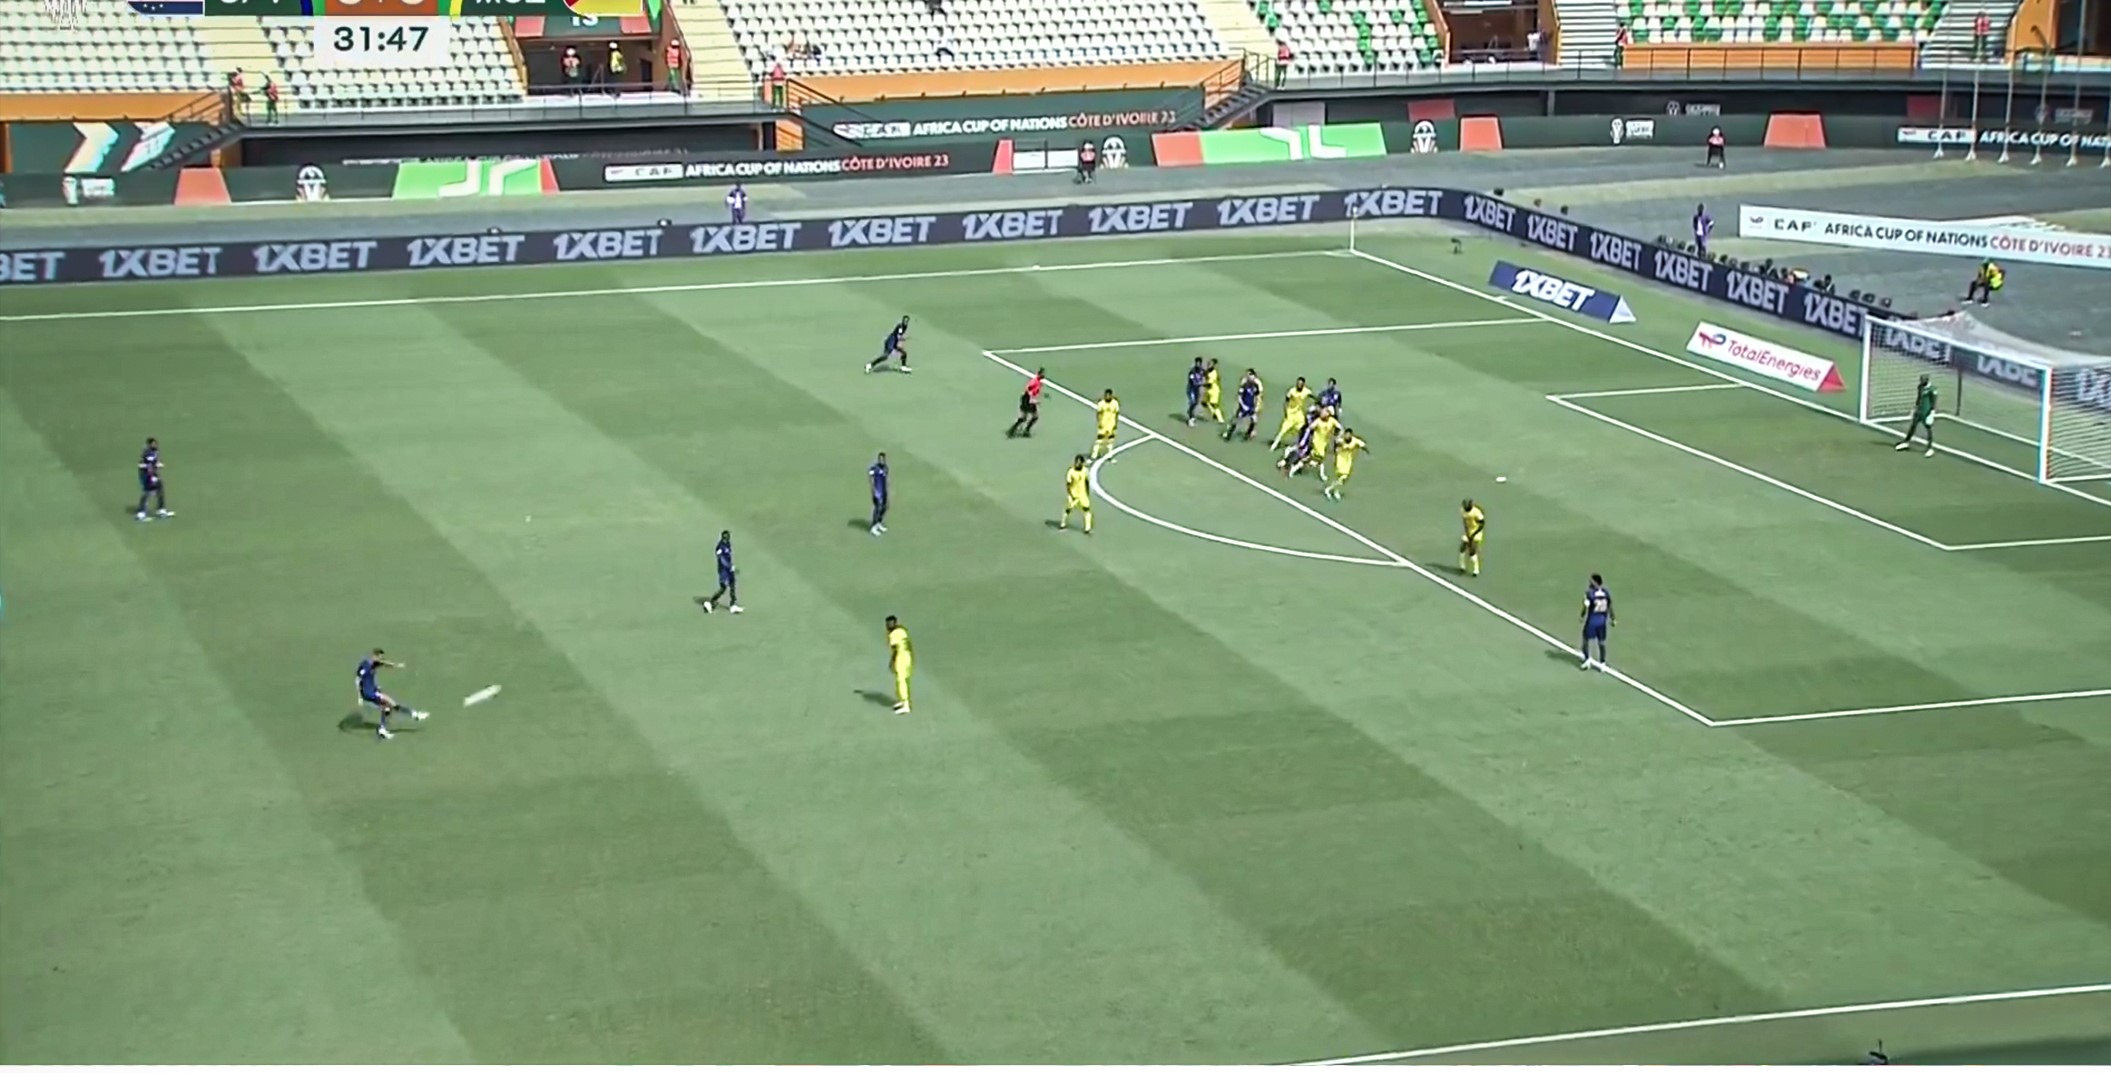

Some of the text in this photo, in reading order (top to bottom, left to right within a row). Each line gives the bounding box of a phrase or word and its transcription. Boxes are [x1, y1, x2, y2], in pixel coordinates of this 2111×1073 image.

[913, 121, 961, 136] AFRICA
[963, 119, 990, 133] CUP
[990, 118, 1009, 131] OF
[1010, 115, 1067, 130] NATIONS
[1068, 112, 1100, 128] CÔTE
[1980, 130, 2028, 144] AFRCA
[685, 163, 735, 178] AFRICA
[736, 162, 764, 177] CUP
[764, 161, 783, 175] OF
[784, 158, 841, 174] NATIONS
[841, 156, 874, 171] CÔTE
[876, 154, 932, 169] D'IVOIRE
[934, 154, 949, 167] 23
[1088, 202, 1194, 232] 1XBET
[1217, 195, 1320, 226] 1XBET
[1345, 190, 1443, 216] 1XBET
[1464, 194, 1517, 233] 1XBET
[690, 224, 802, 255] 1XBET
[829, 216, 936, 246] 1XBET
[963, 210, 1063, 240] 1XBET
[1527, 214, 1579, 252] 1XBET
[1775, 218, 1812, 232] CAF
[1825, 222, 1873, 238] AFRICA
[1875, 226, 1902, 240] CUP
[1904, 229, 1925, 243] OF
[1926, 231, 1987, 248] NATIONS
[1990, 236, 2026, 250] CÔTE
[253, 241, 377, 272] 1XBET
[407, 234, 525, 266] 1XBET
[554, 229, 663, 261] 1XBET
[1590, 228, 1643, 271] 1XBET
[99, 247, 221, 277] 1XBET
[1654, 249, 1713, 292] 1XBET
[1511, 270, 1596, 313] 1XBET
[1726, 271, 1789, 314] 1XBET
[1728, 339, 1821, 381] TotalEnergies
